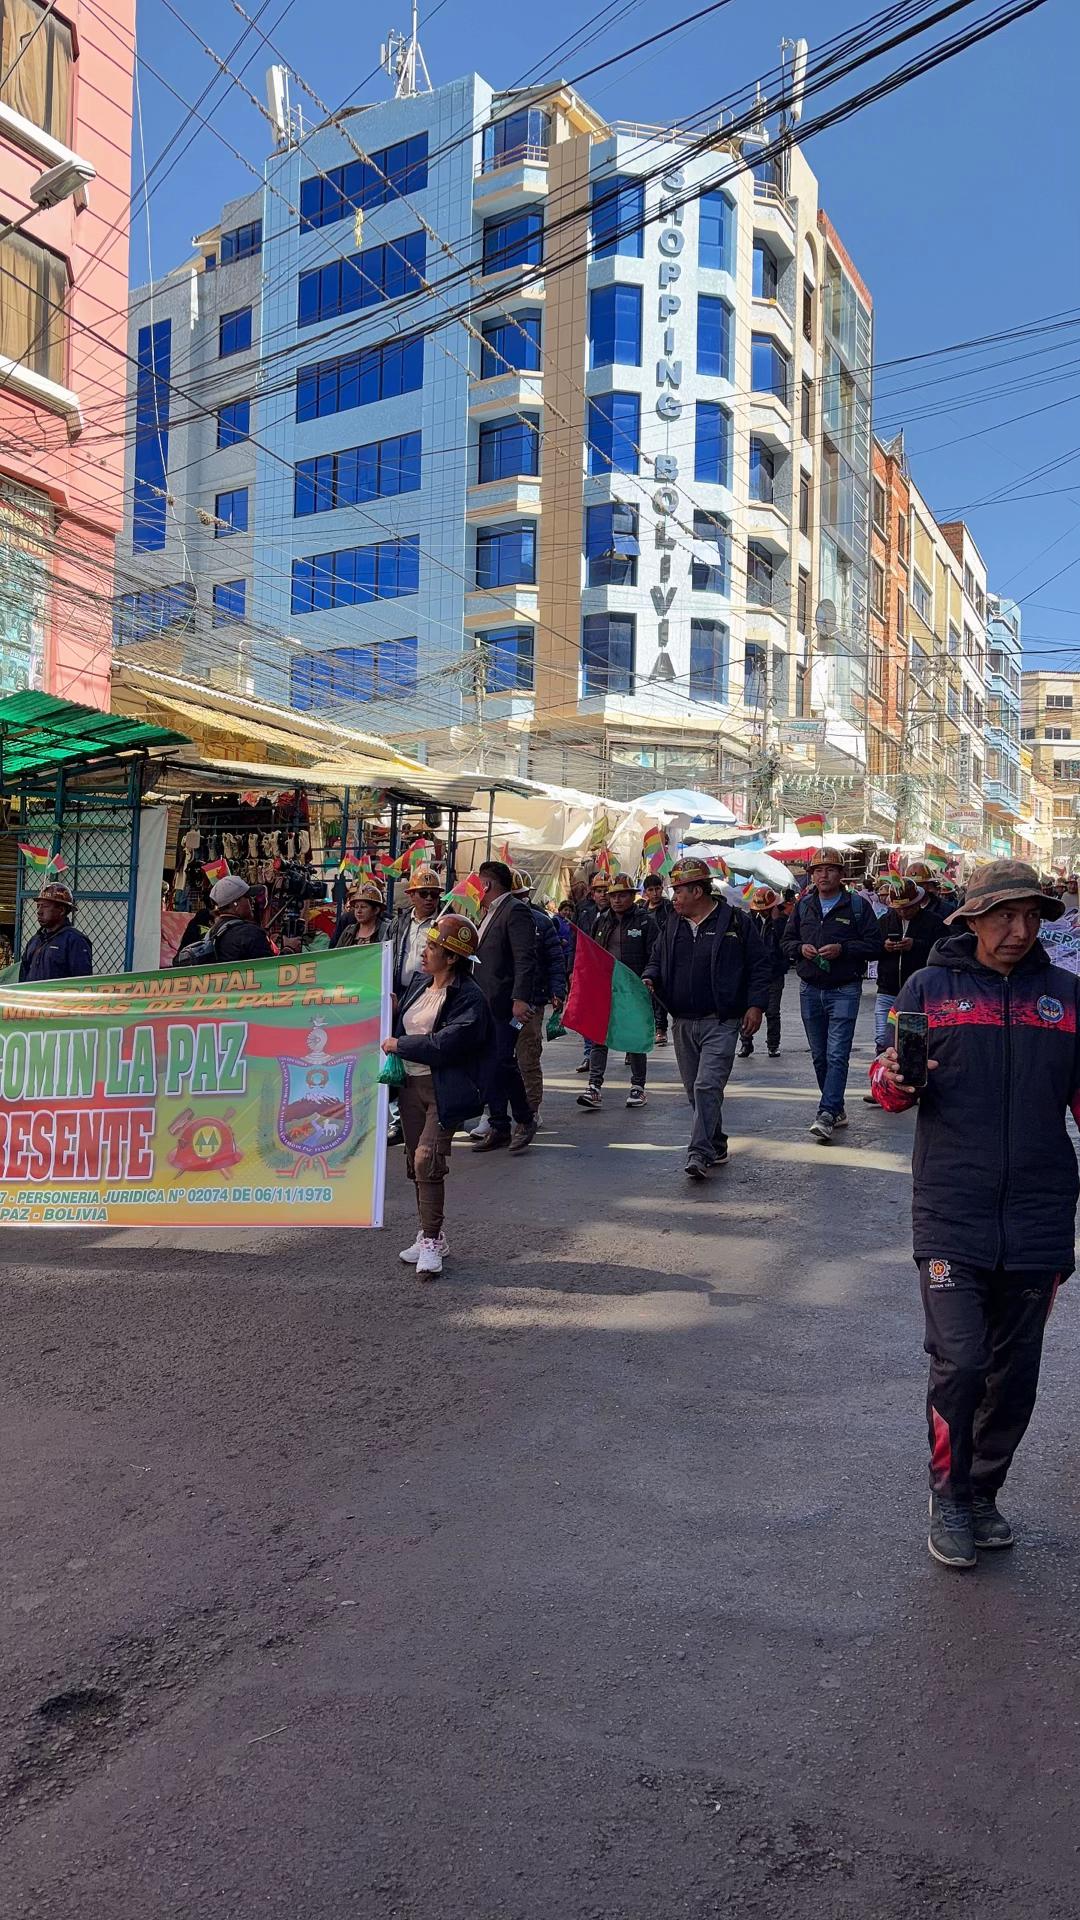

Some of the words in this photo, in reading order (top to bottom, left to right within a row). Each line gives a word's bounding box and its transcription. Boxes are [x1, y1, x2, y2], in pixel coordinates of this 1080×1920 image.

[656, 167, 685, 421] SHOPPING
[650, 454, 680, 682] BOLIVIA
[278, 961, 318, 986] DE
[145, 1000, 187, 1013] DE
[192, 997, 229, 1011] LA
[236, 990, 297, 1010] PAZ
[302, 985, 360, 1005] R.L.
[104, 1026, 157, 1098] LA
[165, 1021, 248, 1096] PAZ
[16, 1190, 101, 1205] PERSONERIA
[102, 1189, 165, 1204] JURIDICA
[187, 1187, 229, 1204] 02074
[232, 1187, 251, 1203] DE
[254, 1186, 333, 1203] 06/11/1978
[0, 1207, 31, 1221] PAZ
[43, 1206, 109, 1222] BOLIVIA
